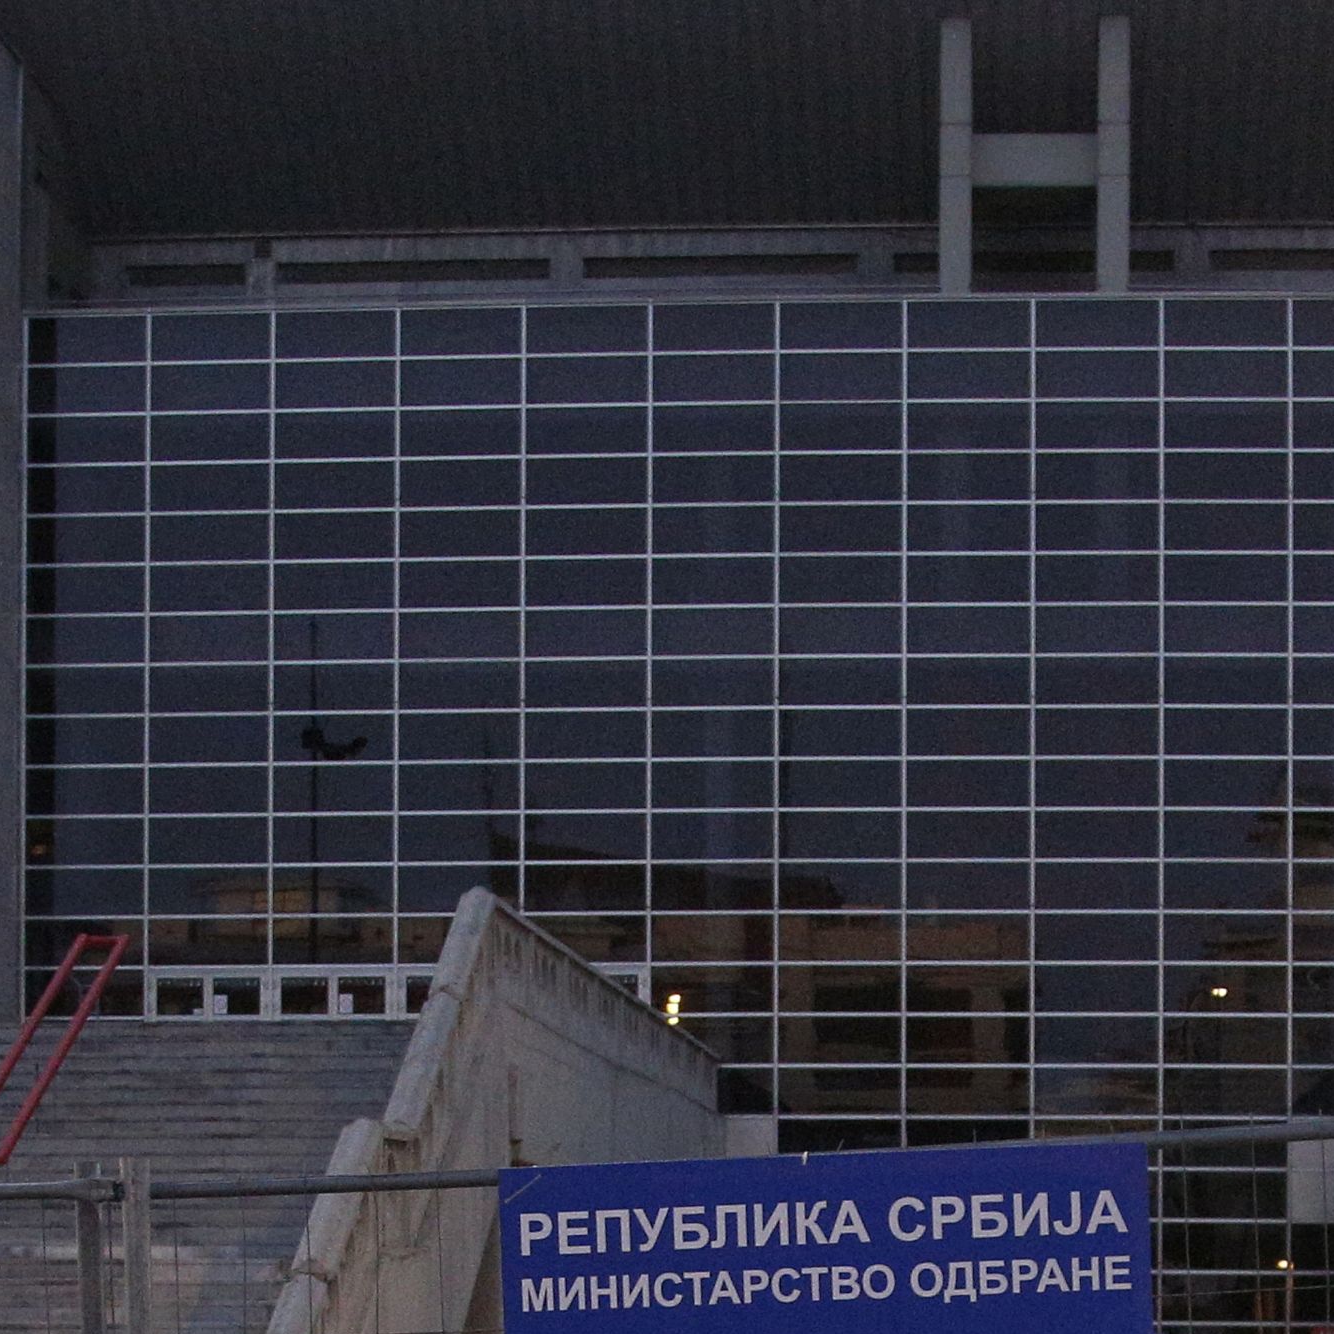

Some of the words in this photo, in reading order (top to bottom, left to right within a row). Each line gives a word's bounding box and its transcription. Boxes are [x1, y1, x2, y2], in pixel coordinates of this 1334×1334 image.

[520, 1200, 870, 1255] РЕПУБЛИКА
[889, 1190, 1127, 1241] СРБИЈА
[522, 1265, 894, 1312] МИНИСТАРСТВО
[911, 1256, 1131, 1303] ОДБРАНЕ
